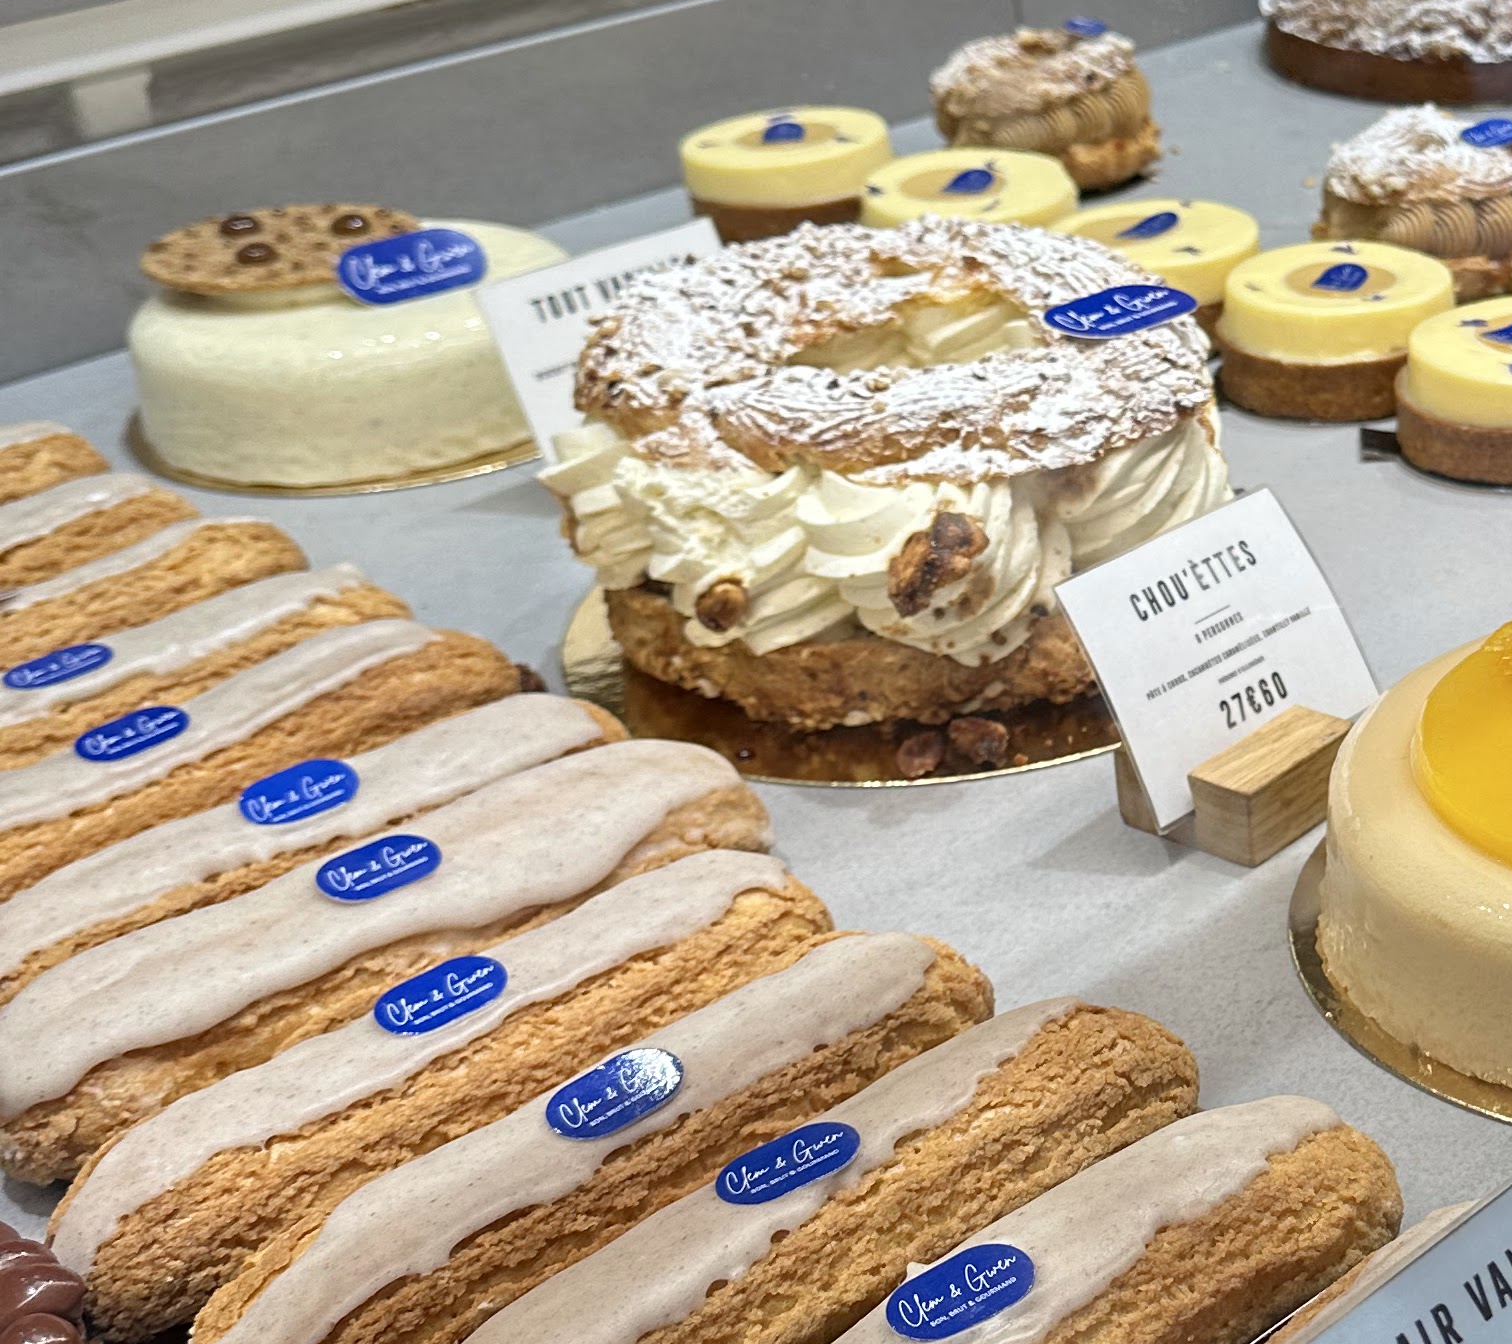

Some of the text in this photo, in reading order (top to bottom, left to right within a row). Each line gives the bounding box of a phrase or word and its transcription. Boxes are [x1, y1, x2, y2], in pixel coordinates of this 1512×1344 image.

[530, 285, 592, 325] TOUT
[1218, 670, 1288, 729] 27€60
[948, 1283, 963, 1298] &
